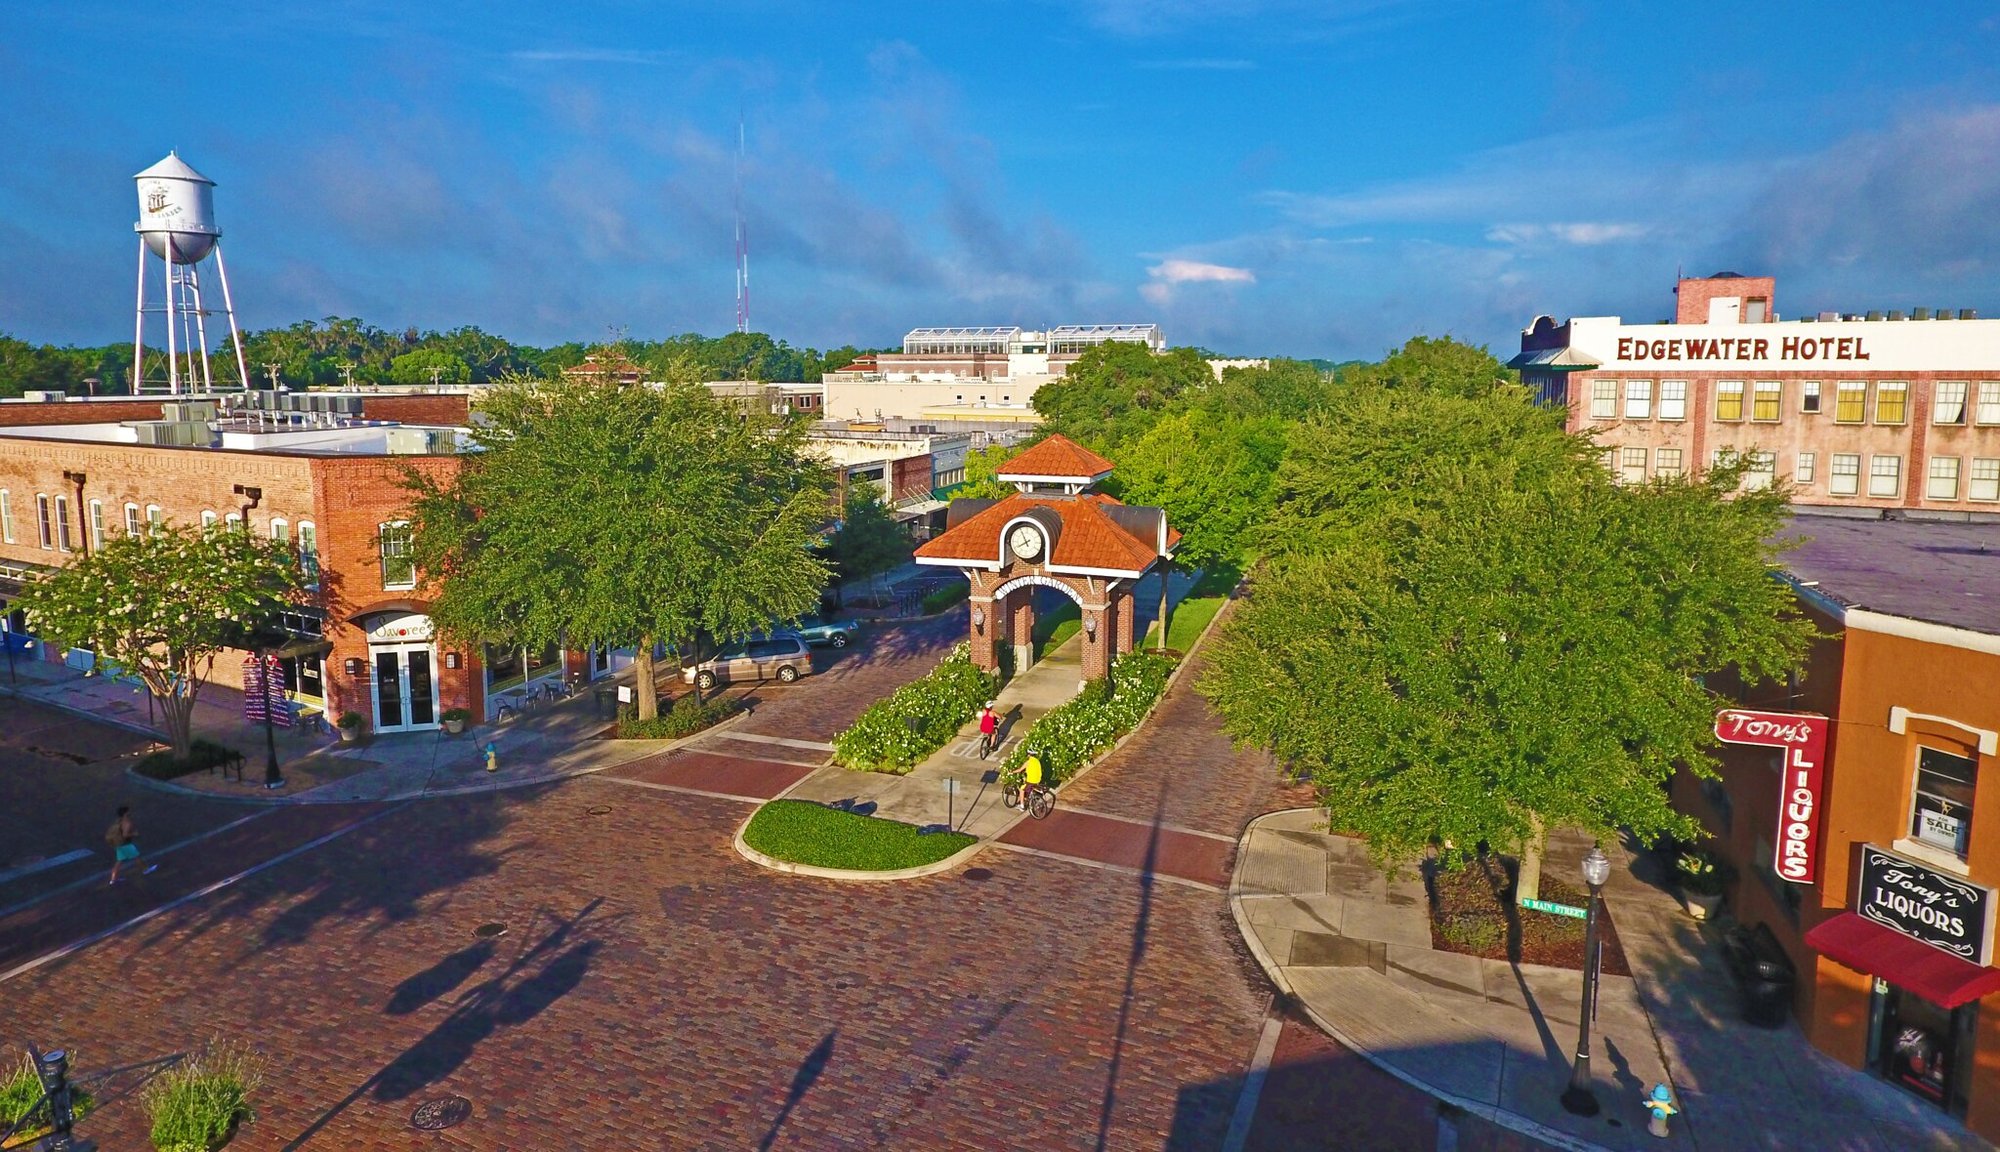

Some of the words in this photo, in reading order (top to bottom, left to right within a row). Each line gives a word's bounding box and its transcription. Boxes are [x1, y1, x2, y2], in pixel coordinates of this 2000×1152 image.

[1617, 337, 1769, 361] EDGEWATER
[1781, 336, 1870, 361] HOTEL
[1784, 749, 1814, 877] LIQUORS
[1926, 817, 1960, 835] SALE
[1937, 828, 1955, 838] OWNER
[1883, 868, 1960, 908] Tony's
[1523, 898, 1530, 908] N
[1532, 900, 1552, 912] MAIN
[1555, 904, 1586, 919] STREET
[1875, 886, 1965, 937] LIQUORS
